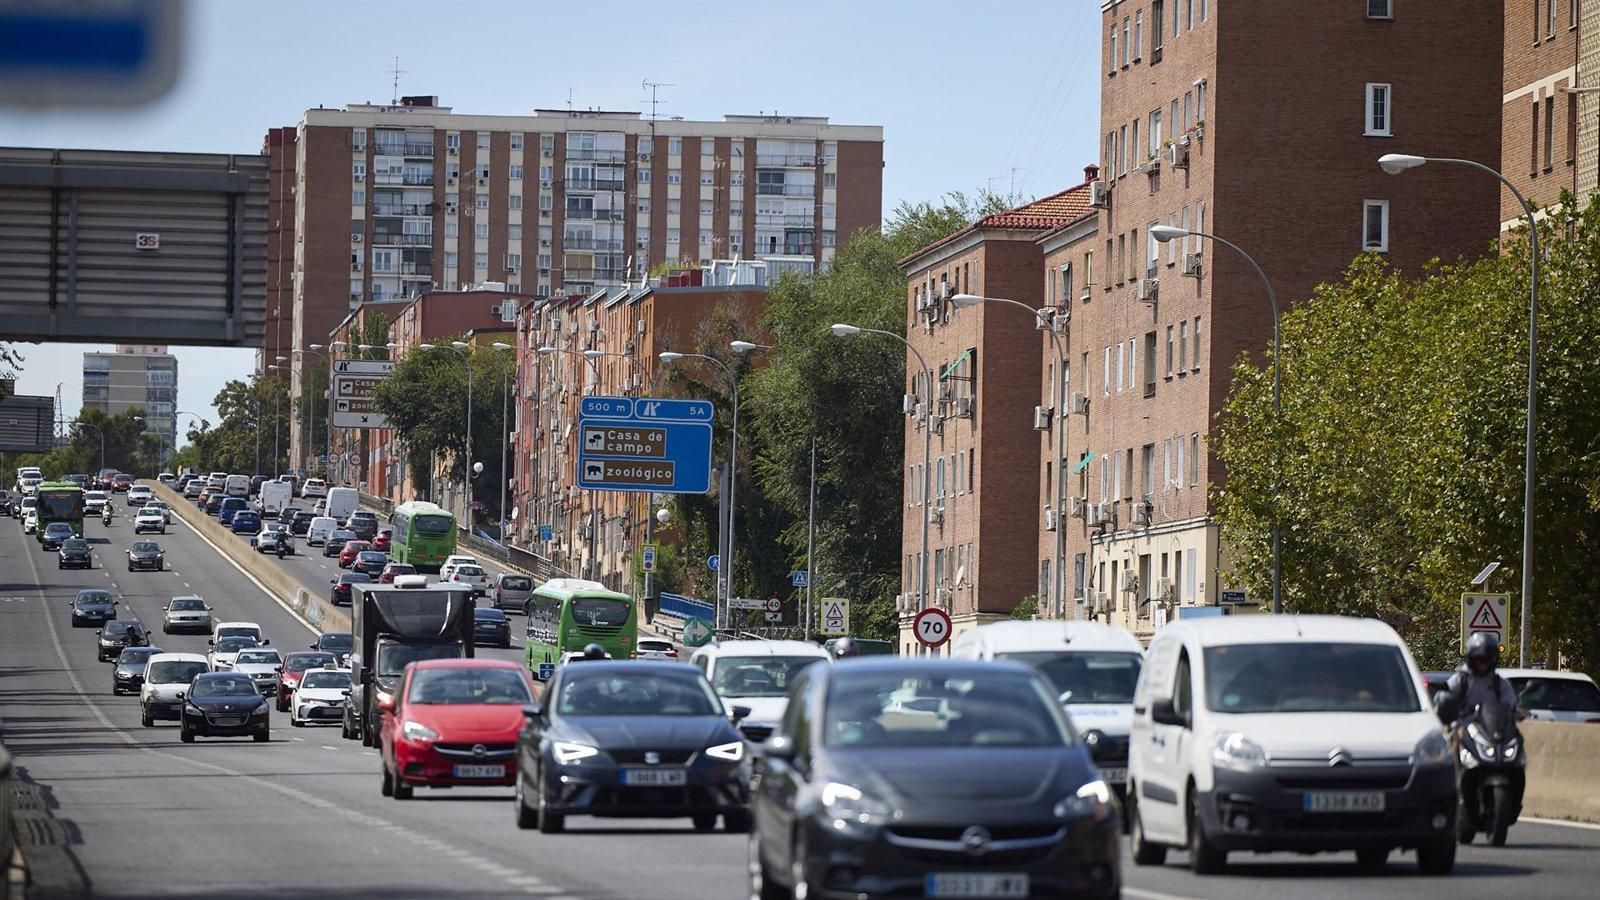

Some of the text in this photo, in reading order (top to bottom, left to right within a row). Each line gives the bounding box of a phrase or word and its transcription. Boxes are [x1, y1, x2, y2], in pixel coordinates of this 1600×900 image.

[588, 402, 609, 412] 500
[690, 407, 705, 416] 5A
[607, 430, 663, 442] Casa de
[607, 442, 652, 455] campo
[606, 467, 672, 481] zoológico
[922, 621, 943, 634] 70
